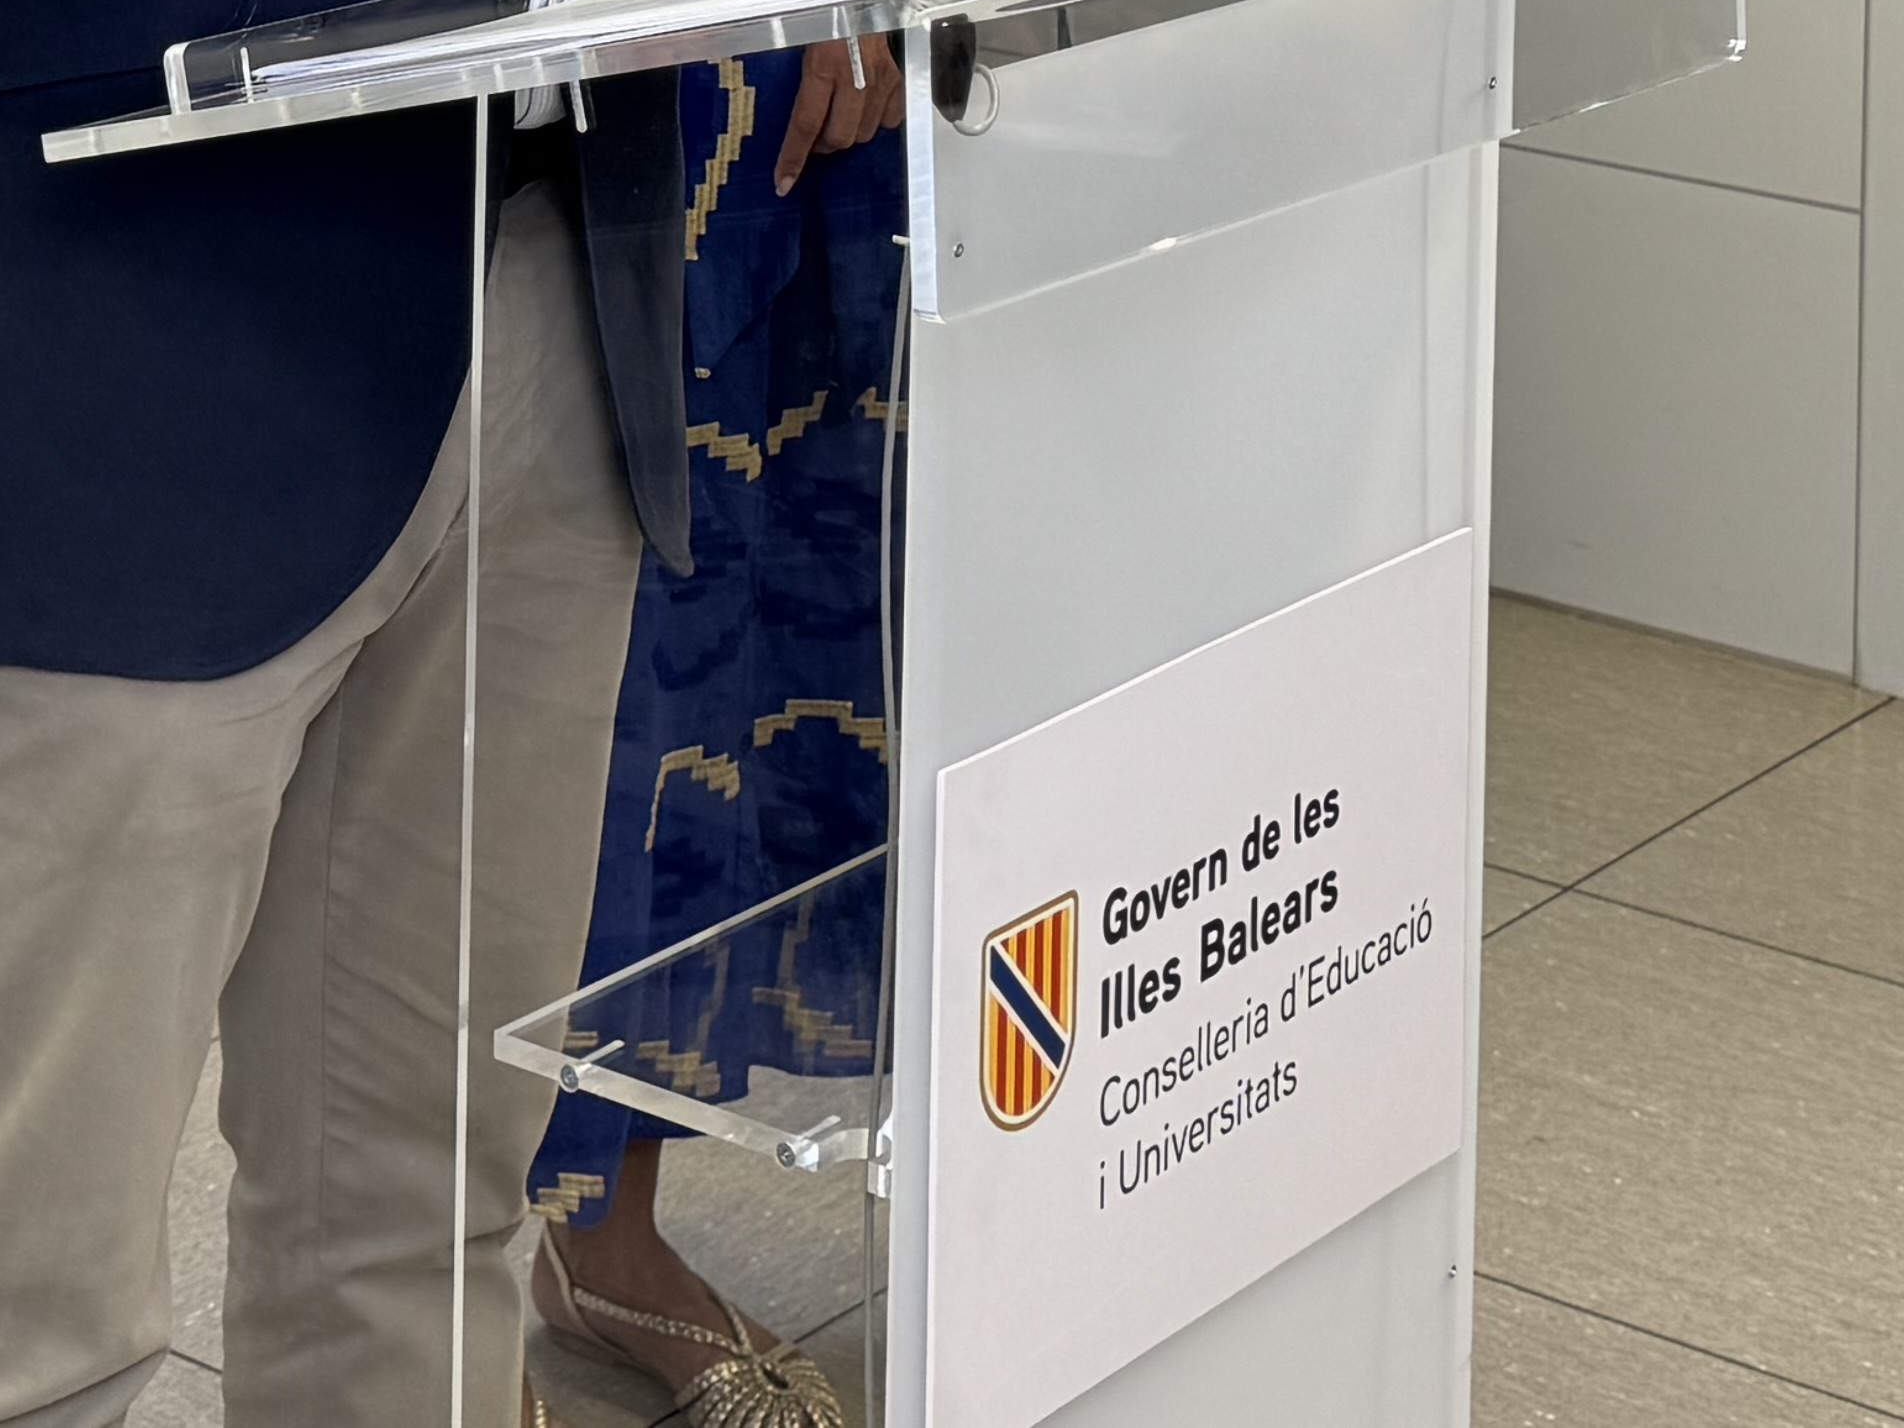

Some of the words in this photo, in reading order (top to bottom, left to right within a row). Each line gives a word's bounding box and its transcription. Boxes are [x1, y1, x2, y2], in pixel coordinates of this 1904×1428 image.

[1102, 847, 1227, 945] Govern
[1241, 814, 1281, 872] de
[1294, 788, 1340, 844] les
[1100, 952, 1182, 1038] Illes
[1200, 869, 1339, 983] Balears
[1100, 998, 1269, 1127] Conselleria
[1280, 897, 1433, 1022] d'Educació
[1099, 1160, 1107, 1210] i
[1119, 1061, 1297, 1195] Universitats
